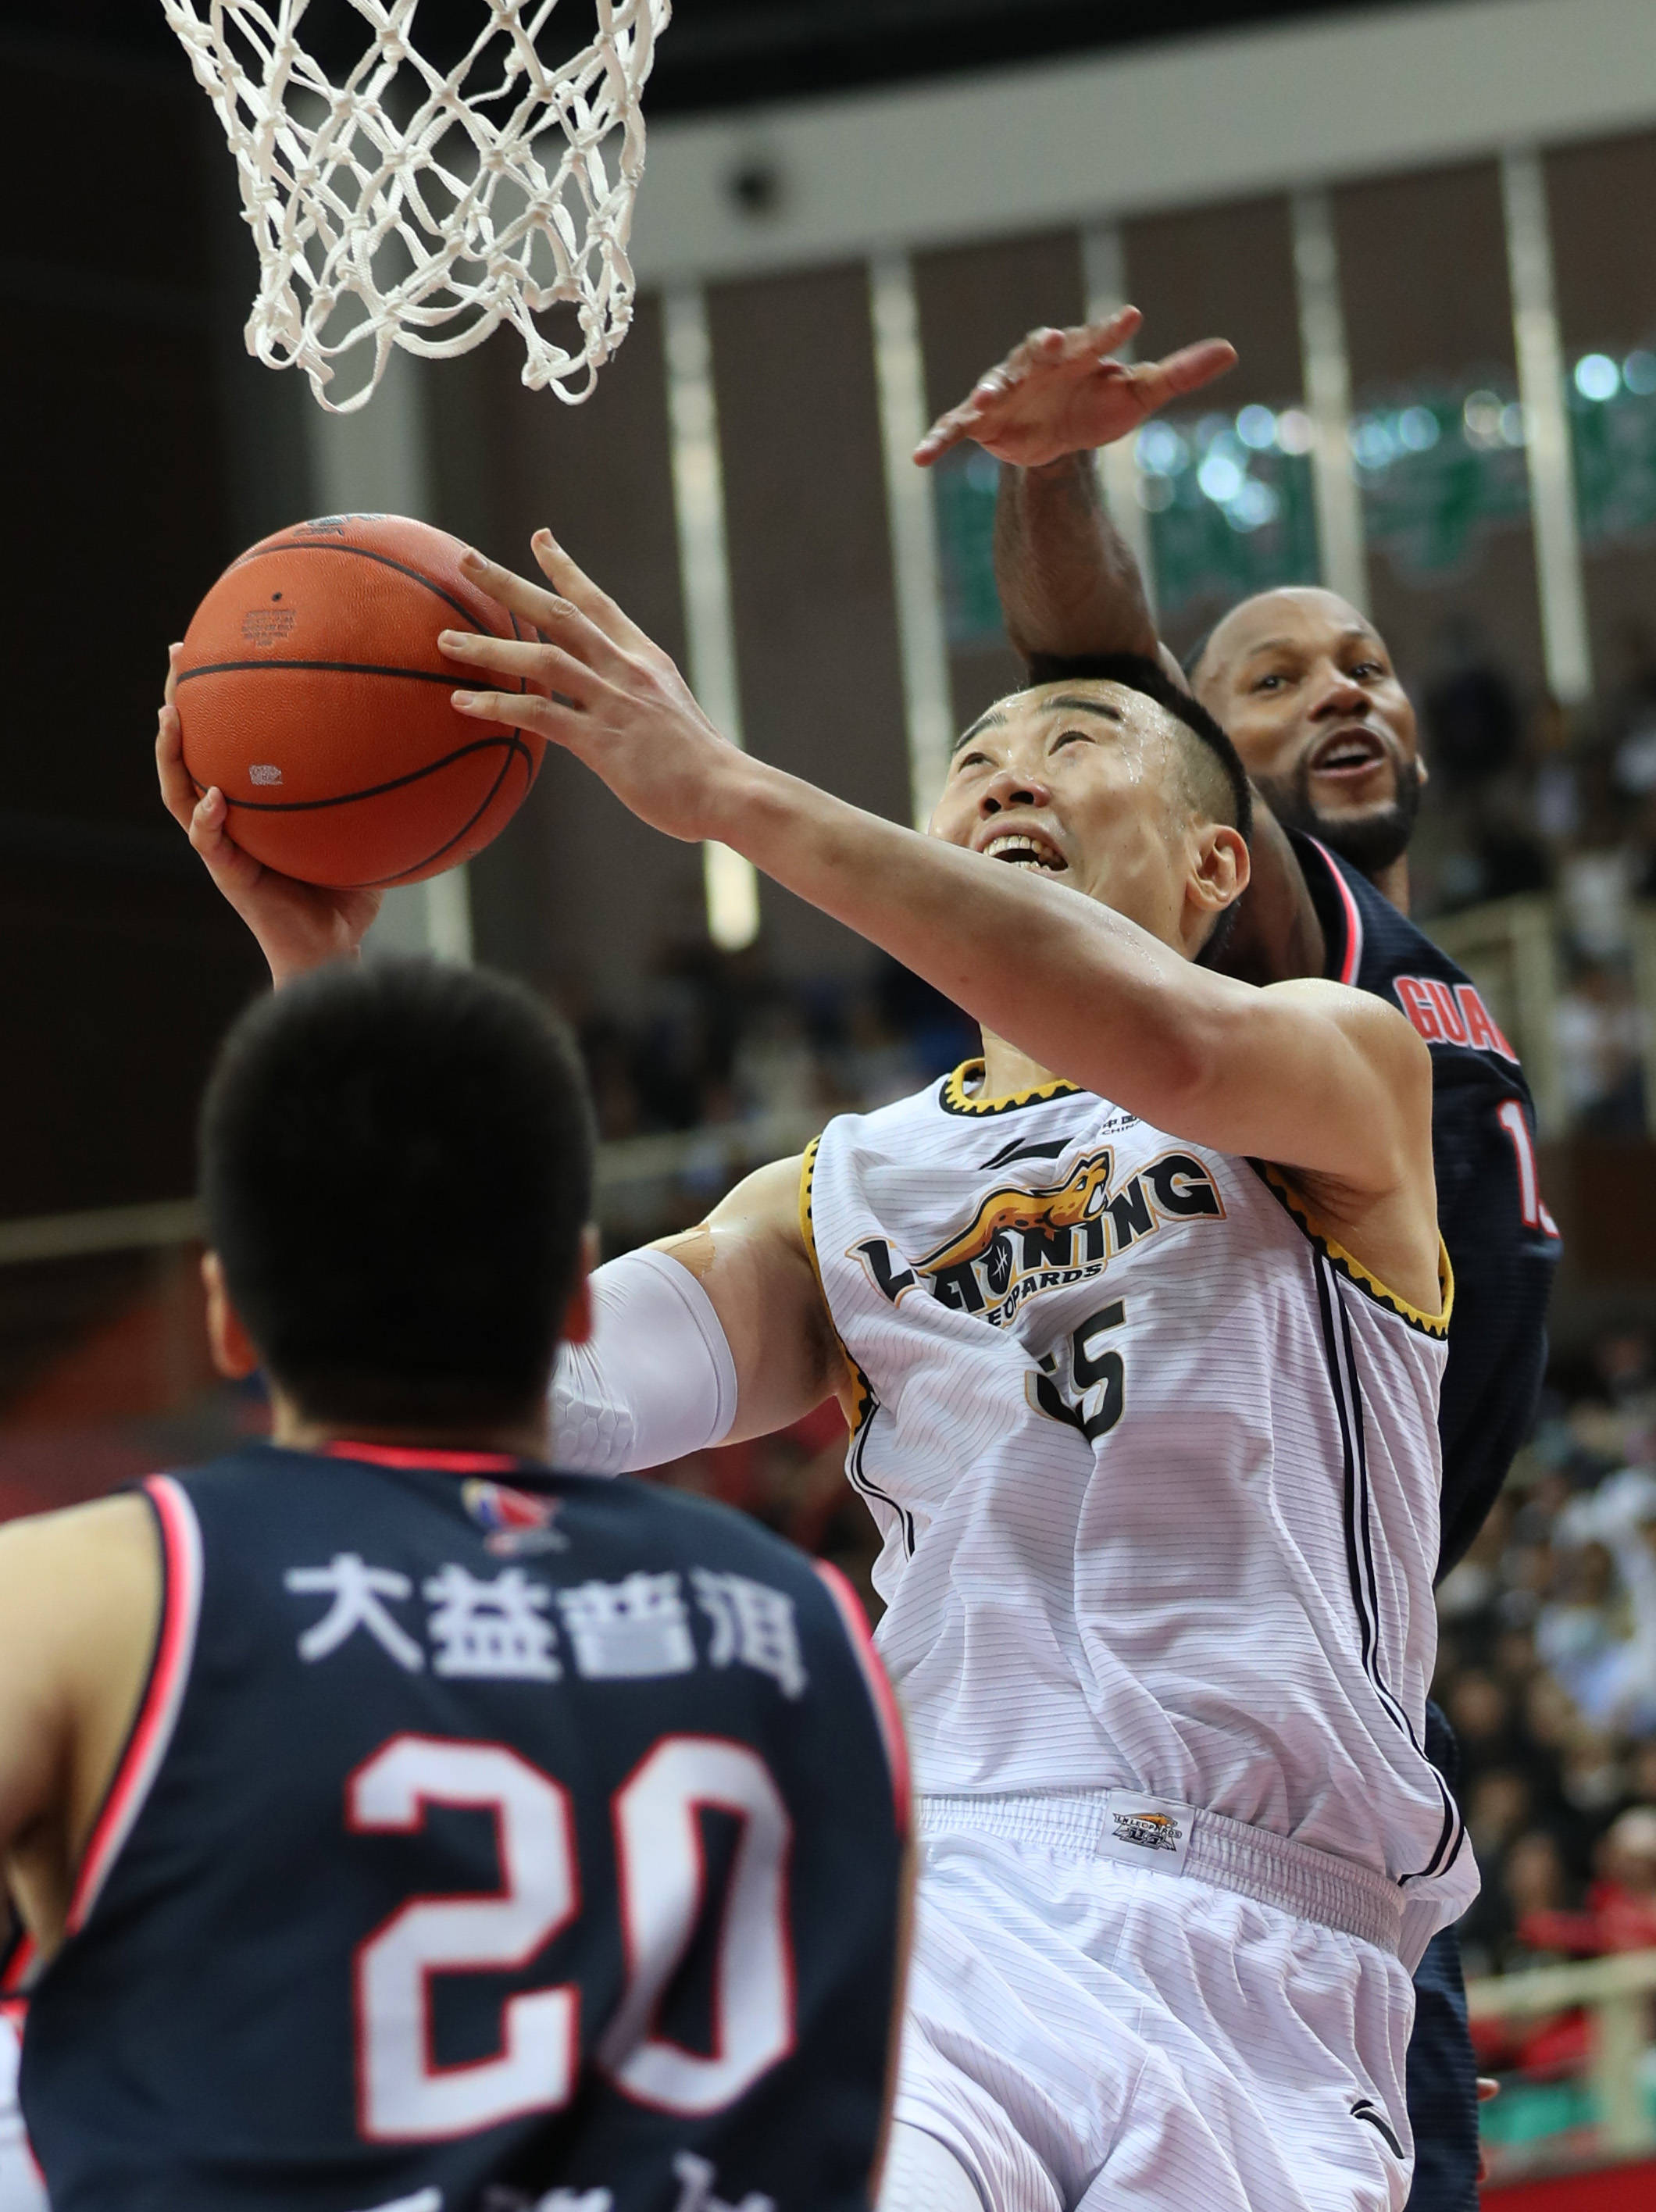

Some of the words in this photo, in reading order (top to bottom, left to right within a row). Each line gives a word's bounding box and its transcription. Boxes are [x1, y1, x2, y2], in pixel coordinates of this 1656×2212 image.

[1497, 1097, 1560, 1239] 1
[977, 1263, 1104, 1327] EOPARDS
[282, 1550, 809, 1701] 大益普洱
[344, 1729, 798, 2146] 20
